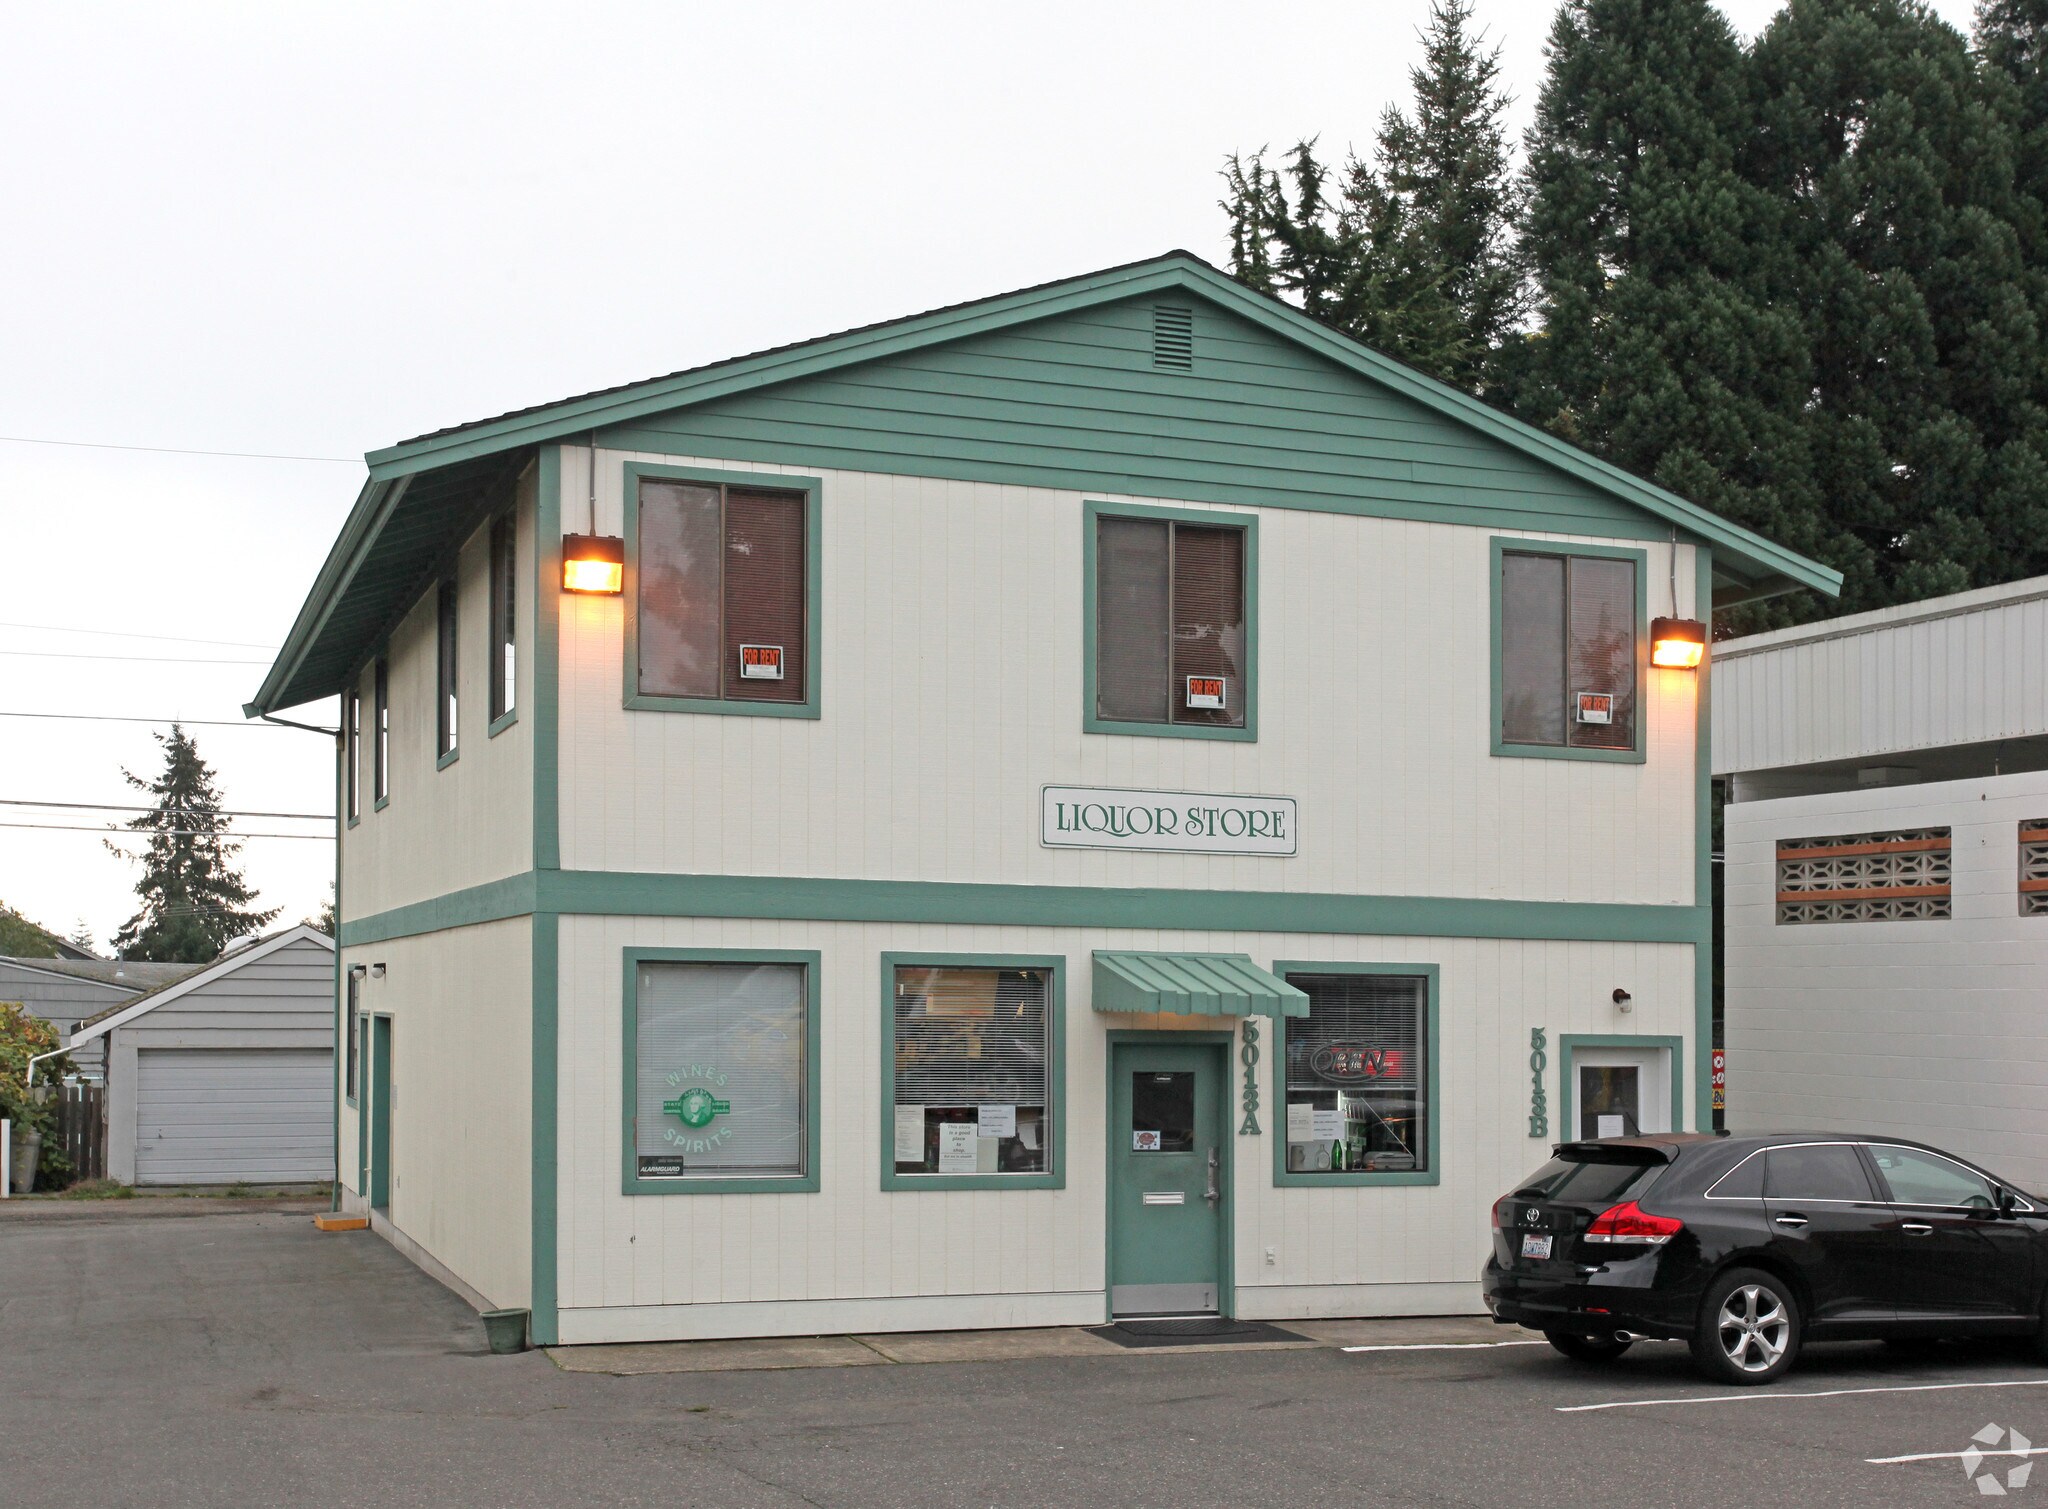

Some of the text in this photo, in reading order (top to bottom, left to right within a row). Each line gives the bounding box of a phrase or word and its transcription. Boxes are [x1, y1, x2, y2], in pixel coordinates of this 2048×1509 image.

[744, 648, 780, 666] FOR RENT
[1191, 679, 1222, 696] FOR RENT
[1055, 803, 1286, 840] LIQUOR STORE
[1315, 1050, 1387, 1073] OPEN
[665, 1063, 728, 1087] WINES
[1239, 1020, 1262, 1135] 5013A
[1528, 1026, 1548, 1138] 5013B
[663, 1127, 732, 1153] SPIRITS
